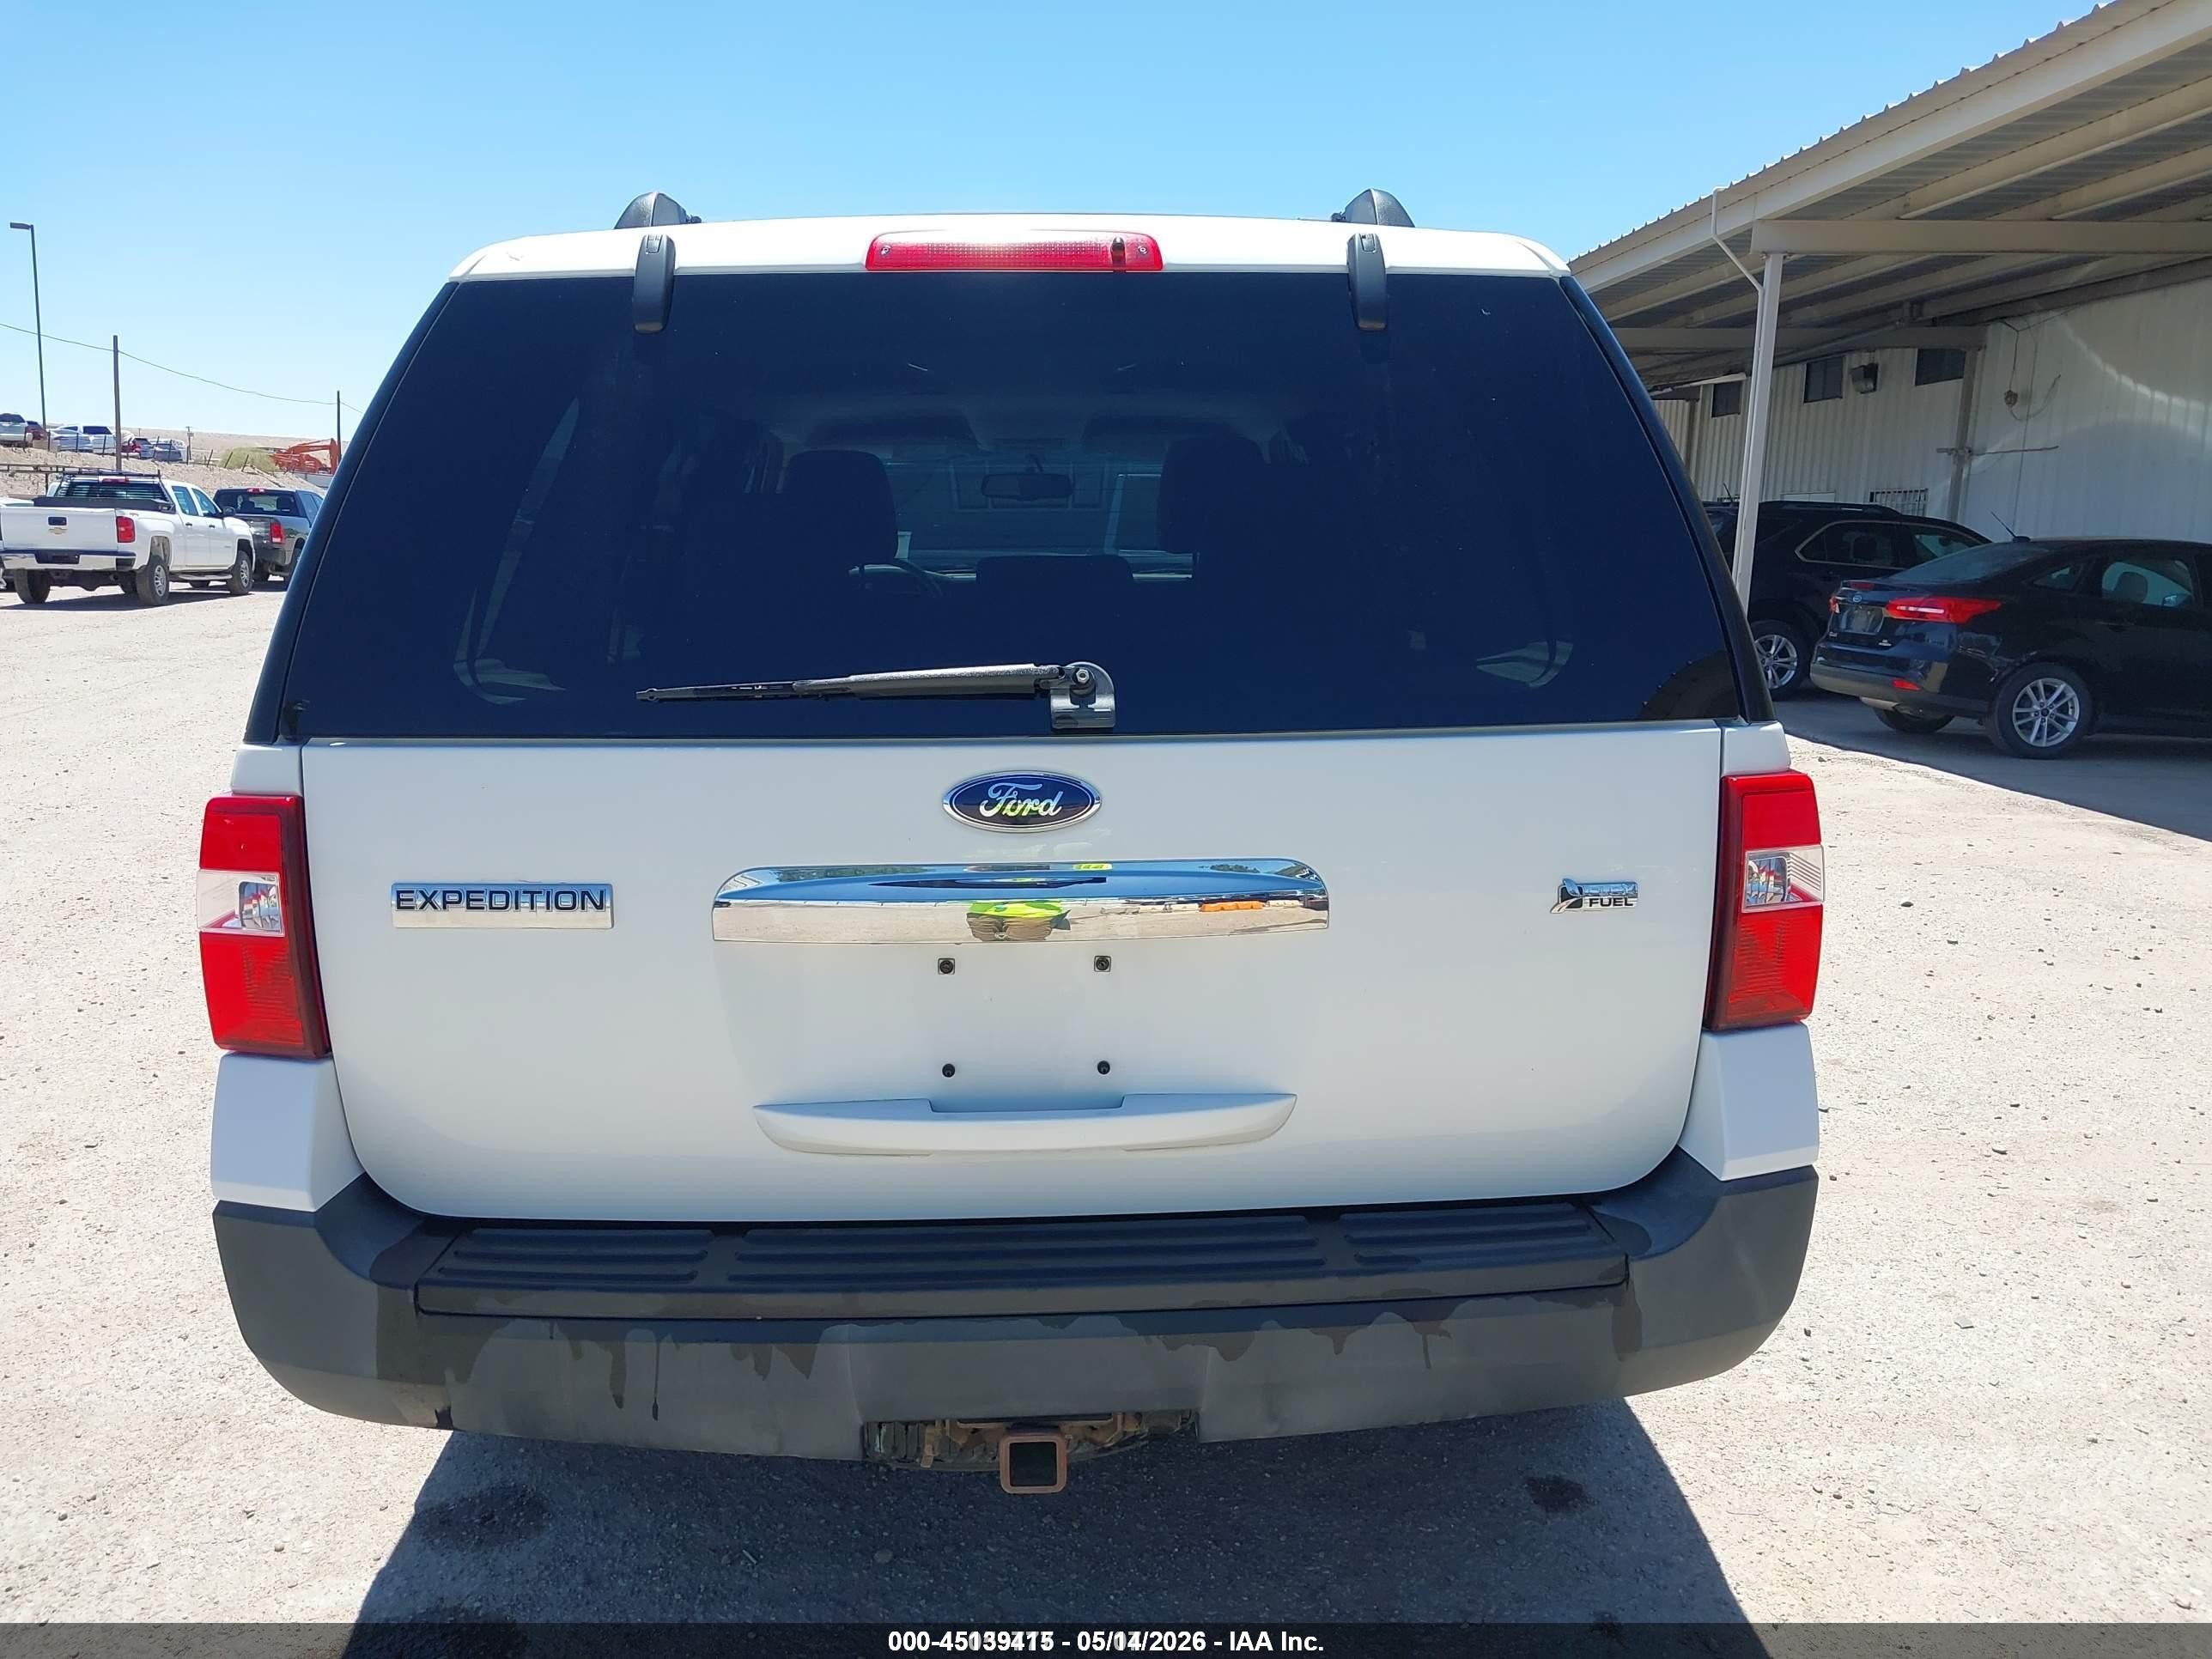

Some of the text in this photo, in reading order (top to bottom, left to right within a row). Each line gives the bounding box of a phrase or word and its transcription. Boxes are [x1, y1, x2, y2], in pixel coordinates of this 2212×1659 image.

[979, 782, 1063, 817] Ford
[396, 889, 605, 911] EXPEDITION
[1589, 896, 1634, 908] FUEL
